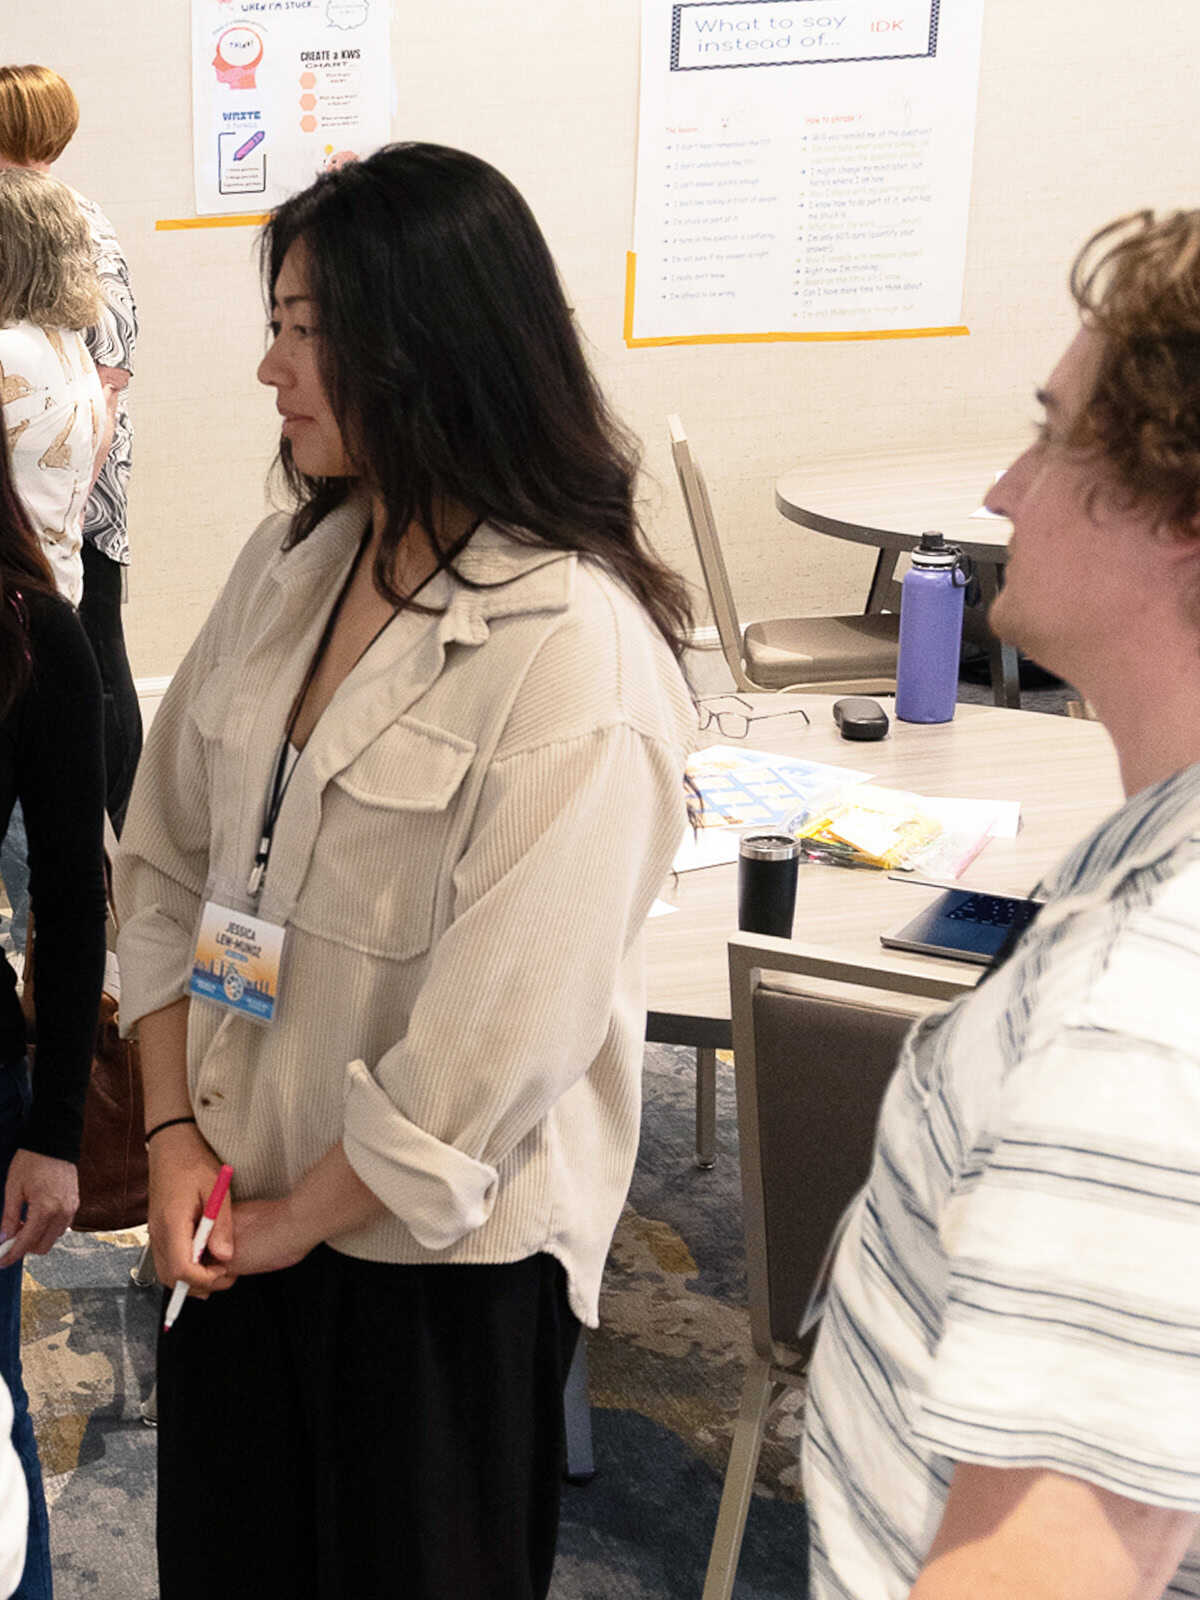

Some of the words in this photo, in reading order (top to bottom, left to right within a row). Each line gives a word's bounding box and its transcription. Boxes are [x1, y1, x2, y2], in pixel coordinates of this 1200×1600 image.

[241, 2, 265, 12] WHEN
[695, 17, 760, 33] What
[769, 16, 793, 30] to
[803, 15, 847, 30] say
[870, 19, 905, 33] IDK
[698, 34, 792, 53] instead
[800, 32, 840, 48] of...
[300, 50, 330, 62] CREATE
[341, 49, 361, 60] KWS
[222, 111, 261, 121] WRITE
